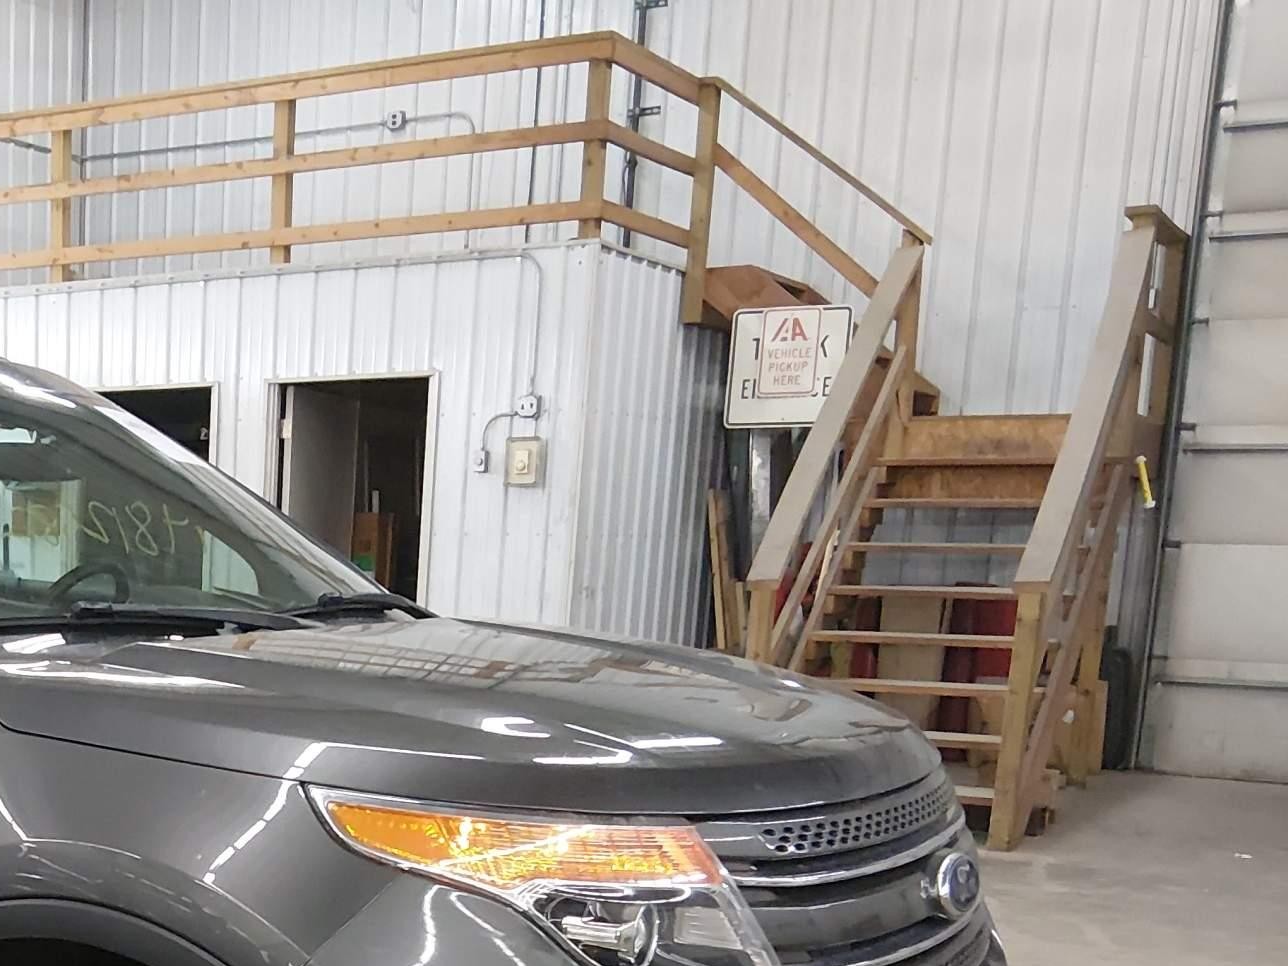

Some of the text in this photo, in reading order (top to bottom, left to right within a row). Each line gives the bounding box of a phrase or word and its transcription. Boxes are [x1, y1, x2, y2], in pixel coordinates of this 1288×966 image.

[767, 347, 812, 360] VEHICLE
[768, 361, 809, 373] PICKUP
[773, 374, 801, 386] HERE
